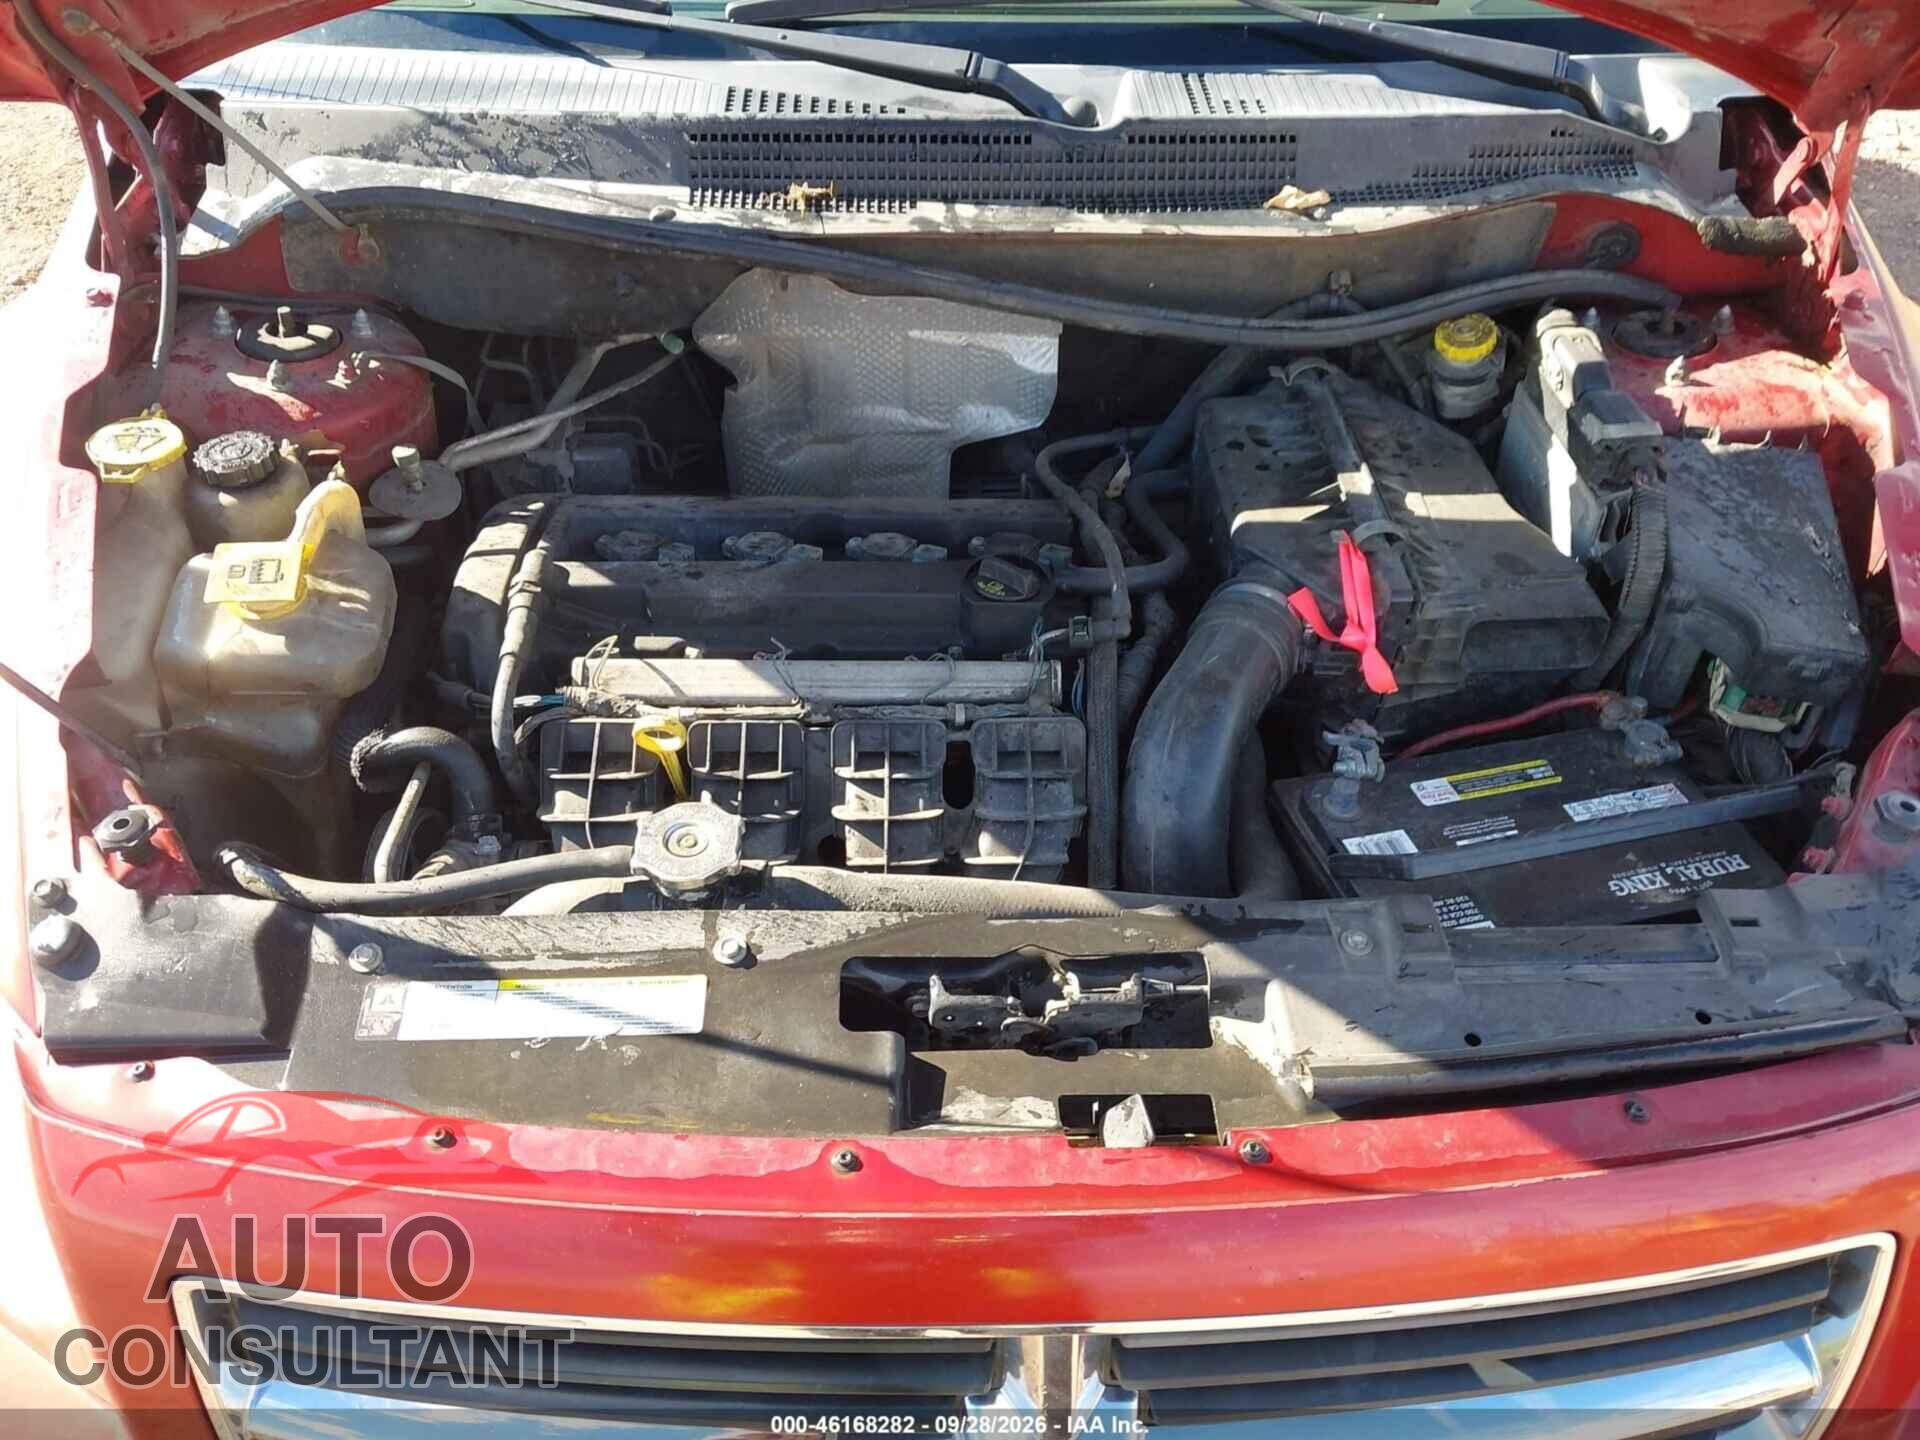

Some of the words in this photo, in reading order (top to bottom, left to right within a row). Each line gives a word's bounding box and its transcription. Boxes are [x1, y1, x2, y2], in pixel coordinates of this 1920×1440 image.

[1666, 853, 1751, 881] RURAL
[1607, 870, 1671, 897] KING
[1448, 910, 1464, 919] CCA
[1459, 913, 1485, 925] GROUP
